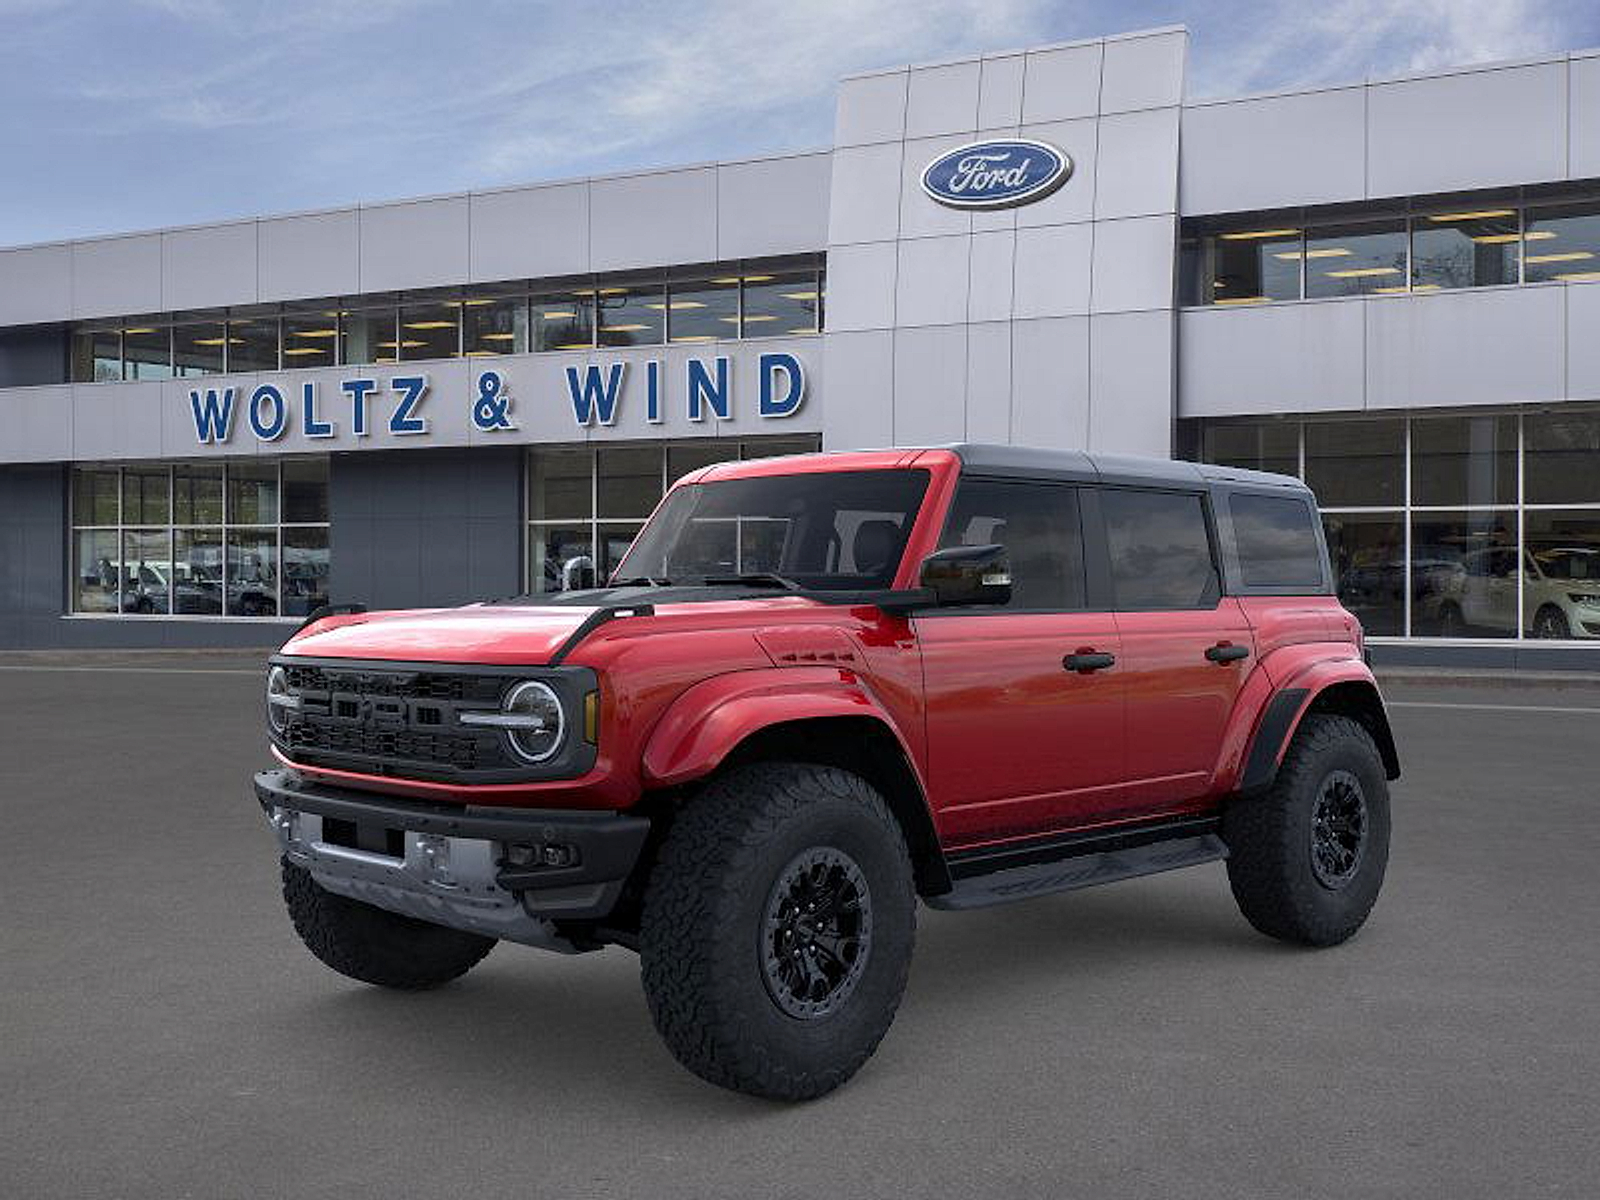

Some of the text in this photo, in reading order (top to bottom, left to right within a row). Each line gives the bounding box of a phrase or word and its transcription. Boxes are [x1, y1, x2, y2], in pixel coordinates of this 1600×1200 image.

[949, 152, 1031, 193] Ford
[189, 351, 806, 443] WOLTZ & WIND
